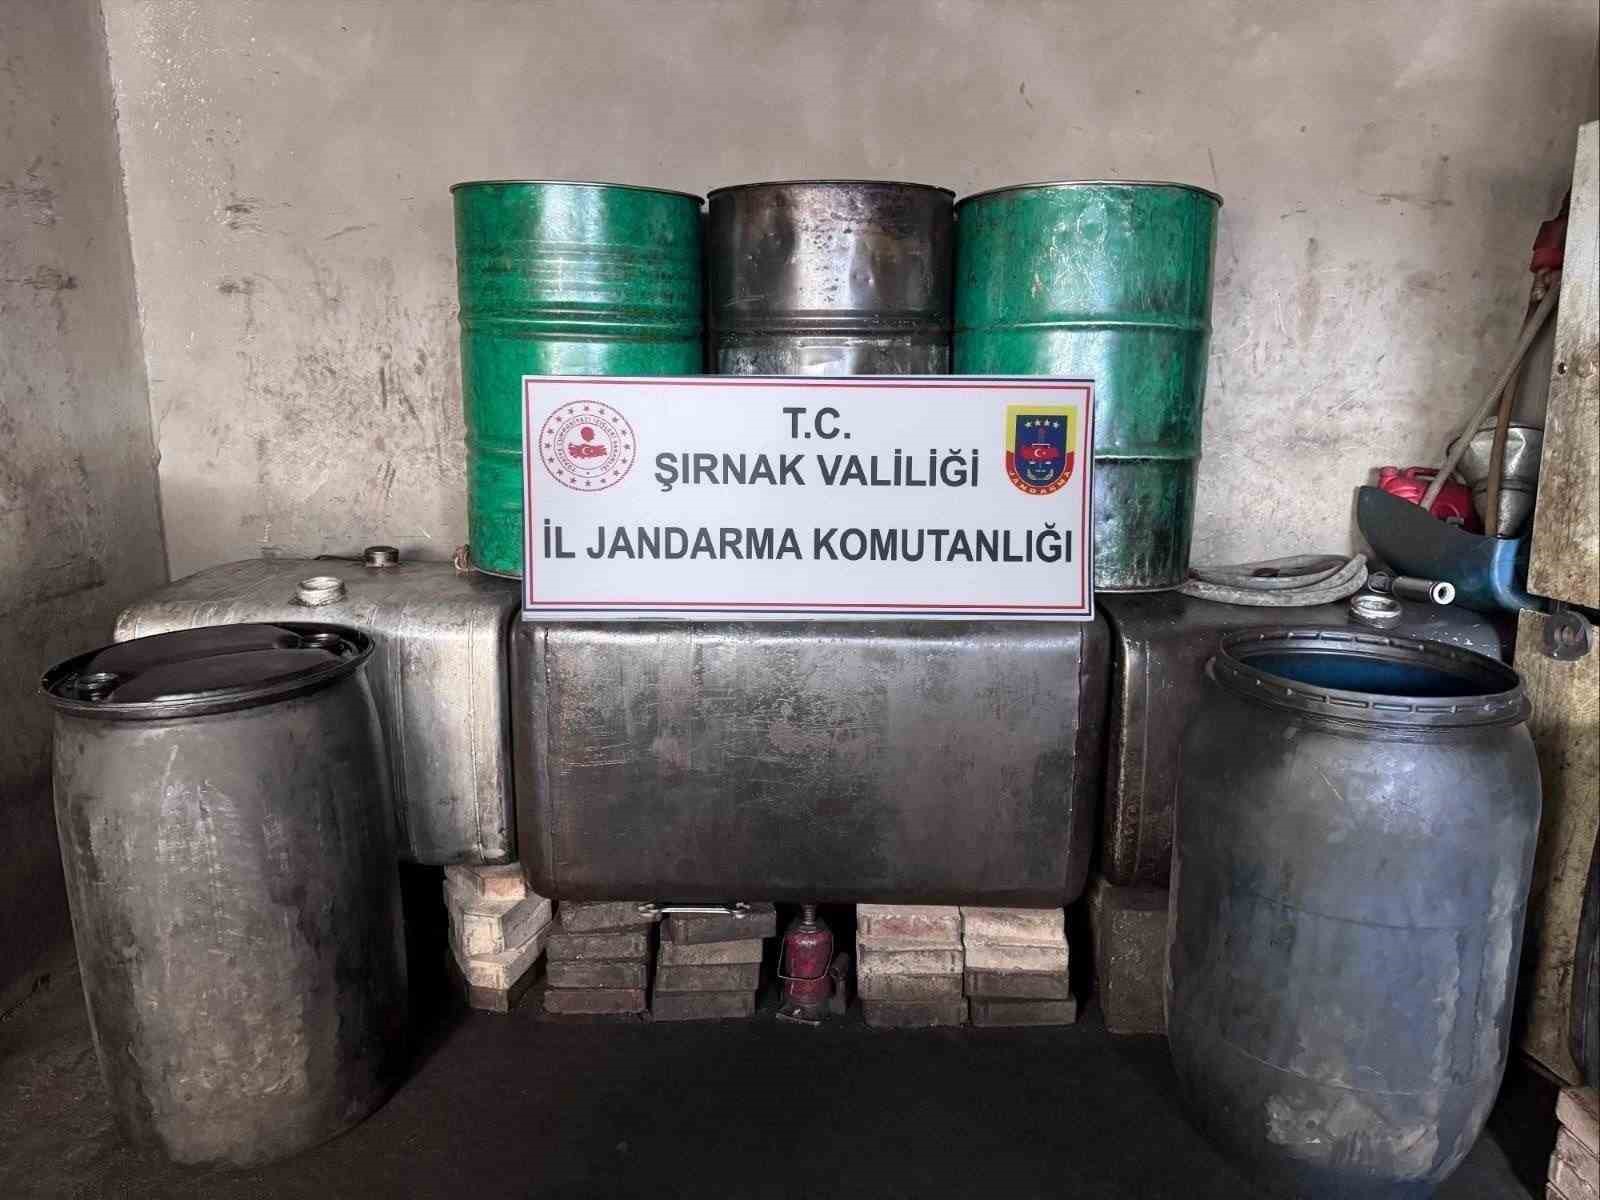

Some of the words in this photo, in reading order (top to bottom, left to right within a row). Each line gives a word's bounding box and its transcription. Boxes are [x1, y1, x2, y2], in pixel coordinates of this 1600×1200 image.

[783, 408, 851, 439] T.C.
[655, 453, 806, 492] ŞIRNAK
[817, 449, 979, 486] VALİLİĞİ
[1009, 470, 1071, 495] JANDARMA
[544, 519, 576, 560] İL
[586, 526, 803, 561] JANDARMA
[814, 522, 1072, 563] KOMUTANLIĞI
